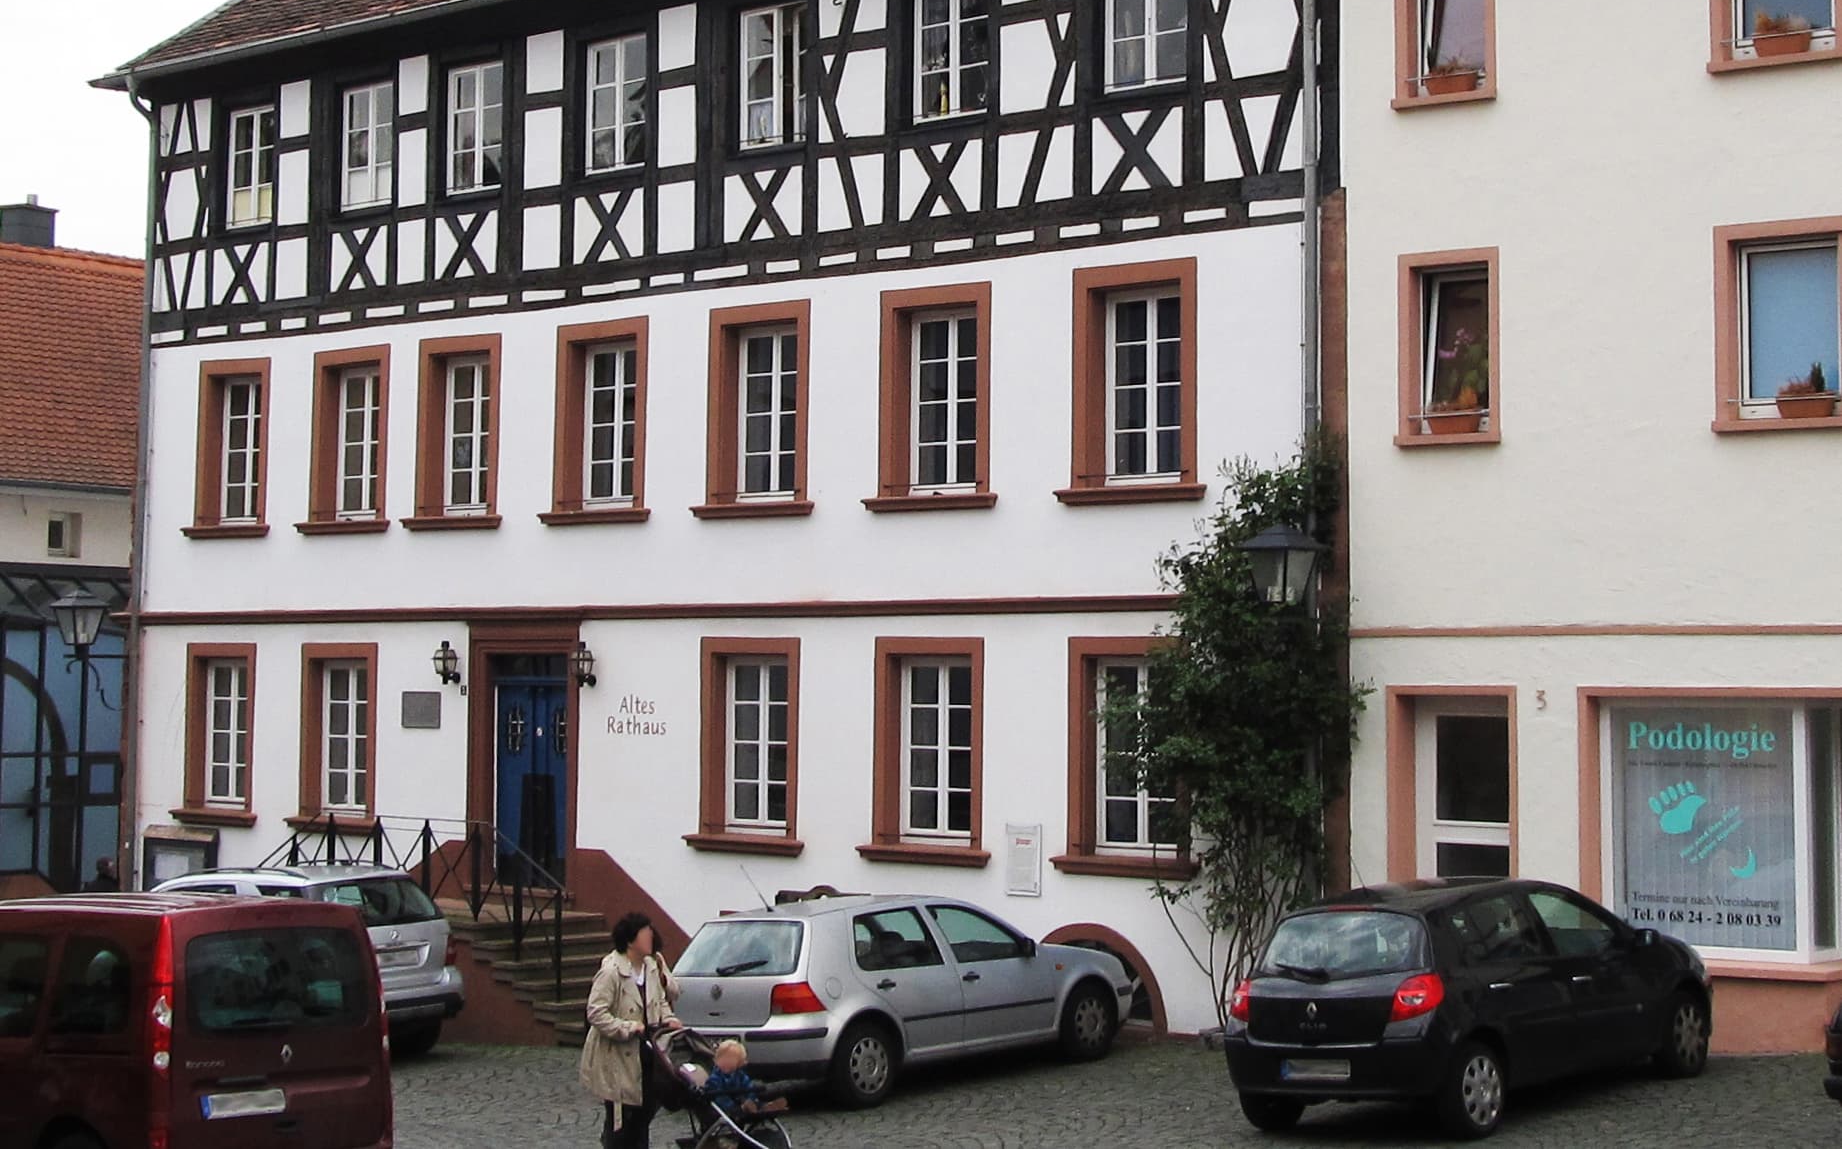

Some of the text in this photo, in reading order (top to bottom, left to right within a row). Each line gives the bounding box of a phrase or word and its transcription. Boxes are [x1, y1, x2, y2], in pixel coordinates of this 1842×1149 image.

[619, 694, 656, 715] Altes
[1536, 690, 1547, 710] 3
[607, 716, 667, 735] Rathaus
[1628, 722, 1776, 759] Podologie
[1632, 891, 1779, 910] Termine nur nach Vereinbarung
[1632, 907, 1654, 921] Tel.
[1658, 909, 1666, 921] 0
[1669, 910, 1684, 922] 68
[1688, 910, 1703, 923] 24
[1716, 912, 1723, 925] 2
[1727, 913, 1743, 925] 08
[1746, 914, 1762, 926] 03
[1765, 915, 1782, 927] 39
